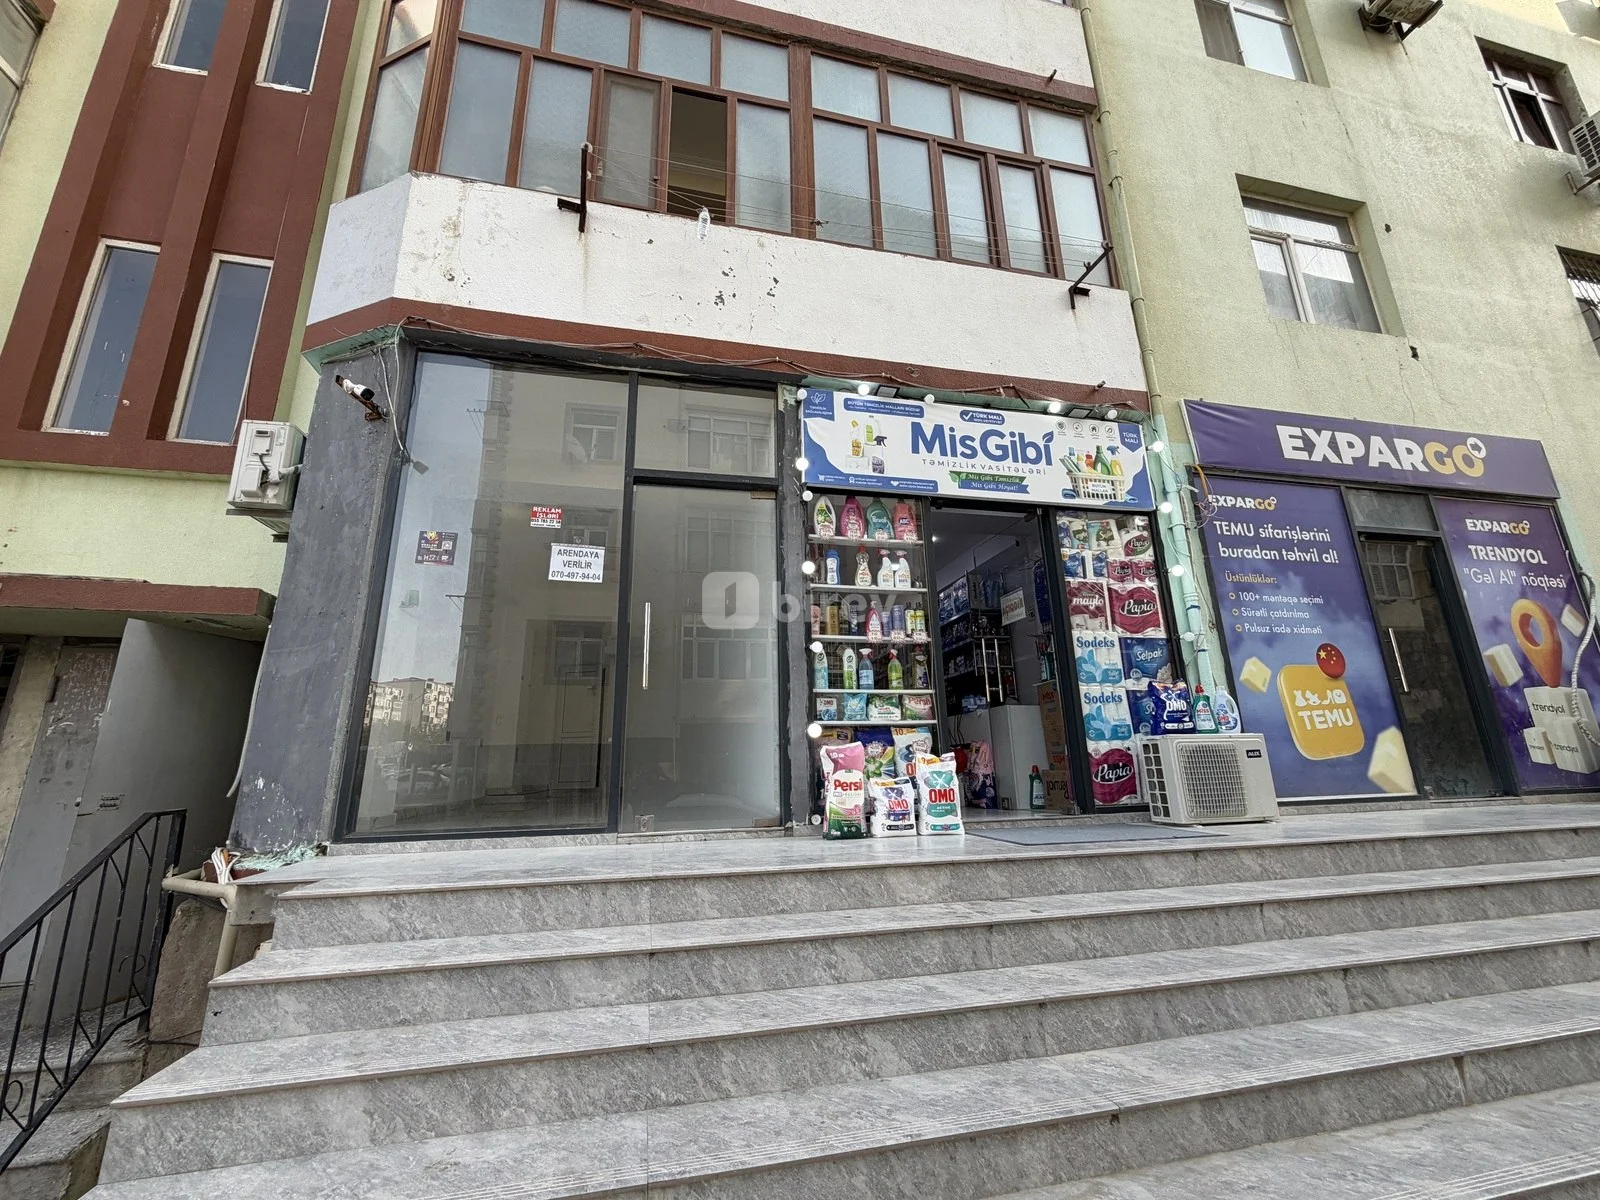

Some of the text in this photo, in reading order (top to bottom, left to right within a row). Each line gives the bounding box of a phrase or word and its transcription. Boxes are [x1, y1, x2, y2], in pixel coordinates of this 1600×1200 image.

[1122, 432, 1139, 440] TÜRK
[1276, 424, 1487, 478] EXPARGO
[921, 459, 1046, 476] TƏMİZLİK VASİTƏLƏRİ
[1208, 494, 1276, 511] EXPARGO
[1213, 521, 1331, 543] TEMU sifarişlərini
[1465, 518, 1530, 535] EXPARGO
[557, 548, 600, 559] ARENDAYA
[1218, 541, 1339, 564] buradan təhvil al!
[1468, 545, 1548, 564] TRENDYOL
[562, 559, 593, 569] VERİLİR
[551, 570, 601, 581] 070-497-94-04
[1521, 573, 1567, 592] nöqtəsi
[1239, 591, 1260, 601] 100+
[1299, 594, 1324, 606] seçimi
[1124, 599, 1155, 616] Papia
[1244, 623, 1271, 633] Pulsuz
[1076, 636, 1115, 648] Sodeks
[1136, 648, 1163, 661] Selpak
[1084, 692, 1122, 705] Sodeks
[1166, 700, 1187, 711] OMO
[1531, 702, 1566, 714] trendyol
[1297, 708, 1353, 730] TEMU
[1097, 764, 1131, 781] Papia
[833, 779, 863, 791] Persil
[929, 789, 955, 803] OMO
[888, 801, 908, 810] OMO
